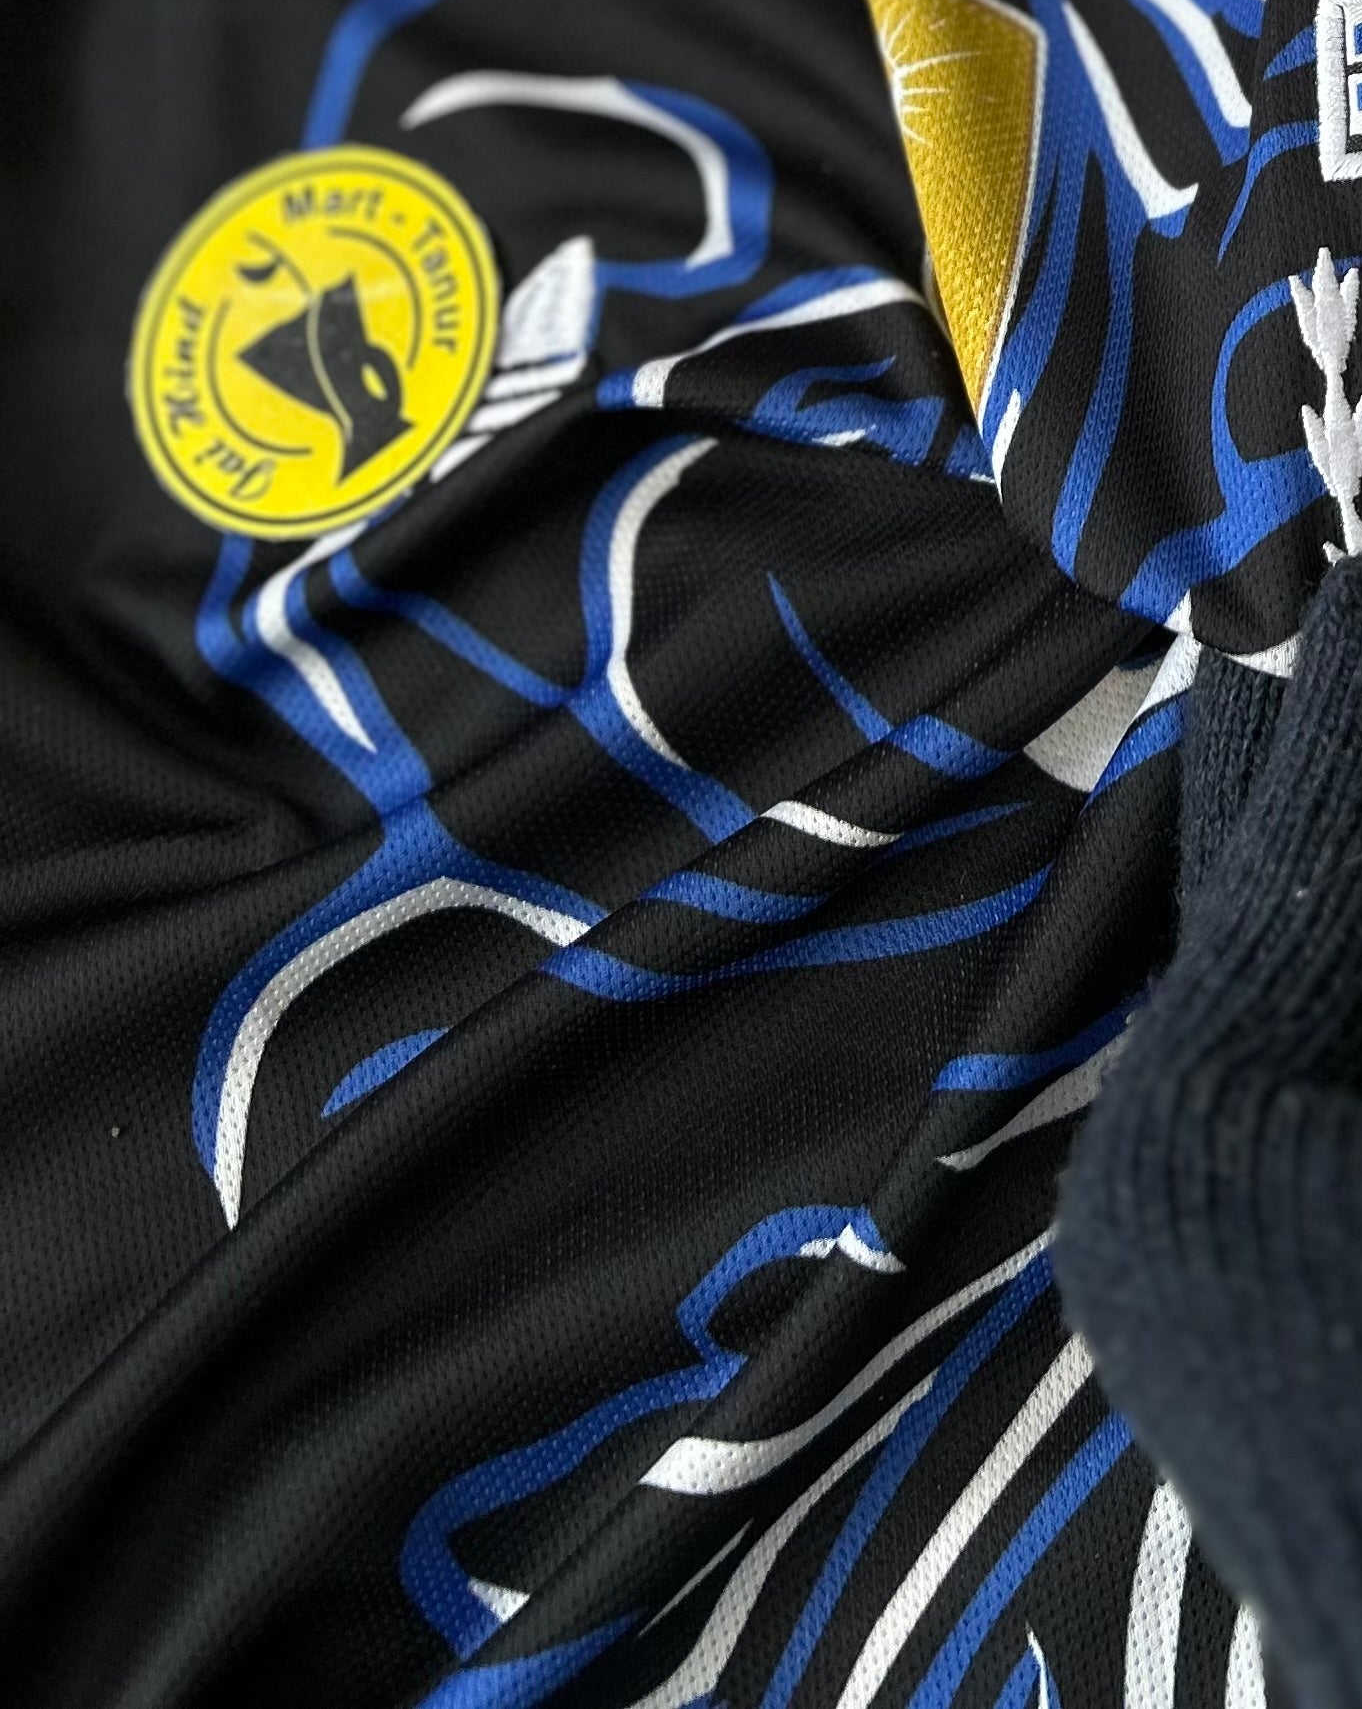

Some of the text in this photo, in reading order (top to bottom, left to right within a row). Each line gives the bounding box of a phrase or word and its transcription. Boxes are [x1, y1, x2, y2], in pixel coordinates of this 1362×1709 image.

[282, 186, 385, 226] Mart
[411, 217, 463, 353] Tanur
[194, 439, 276, 501] Jai
